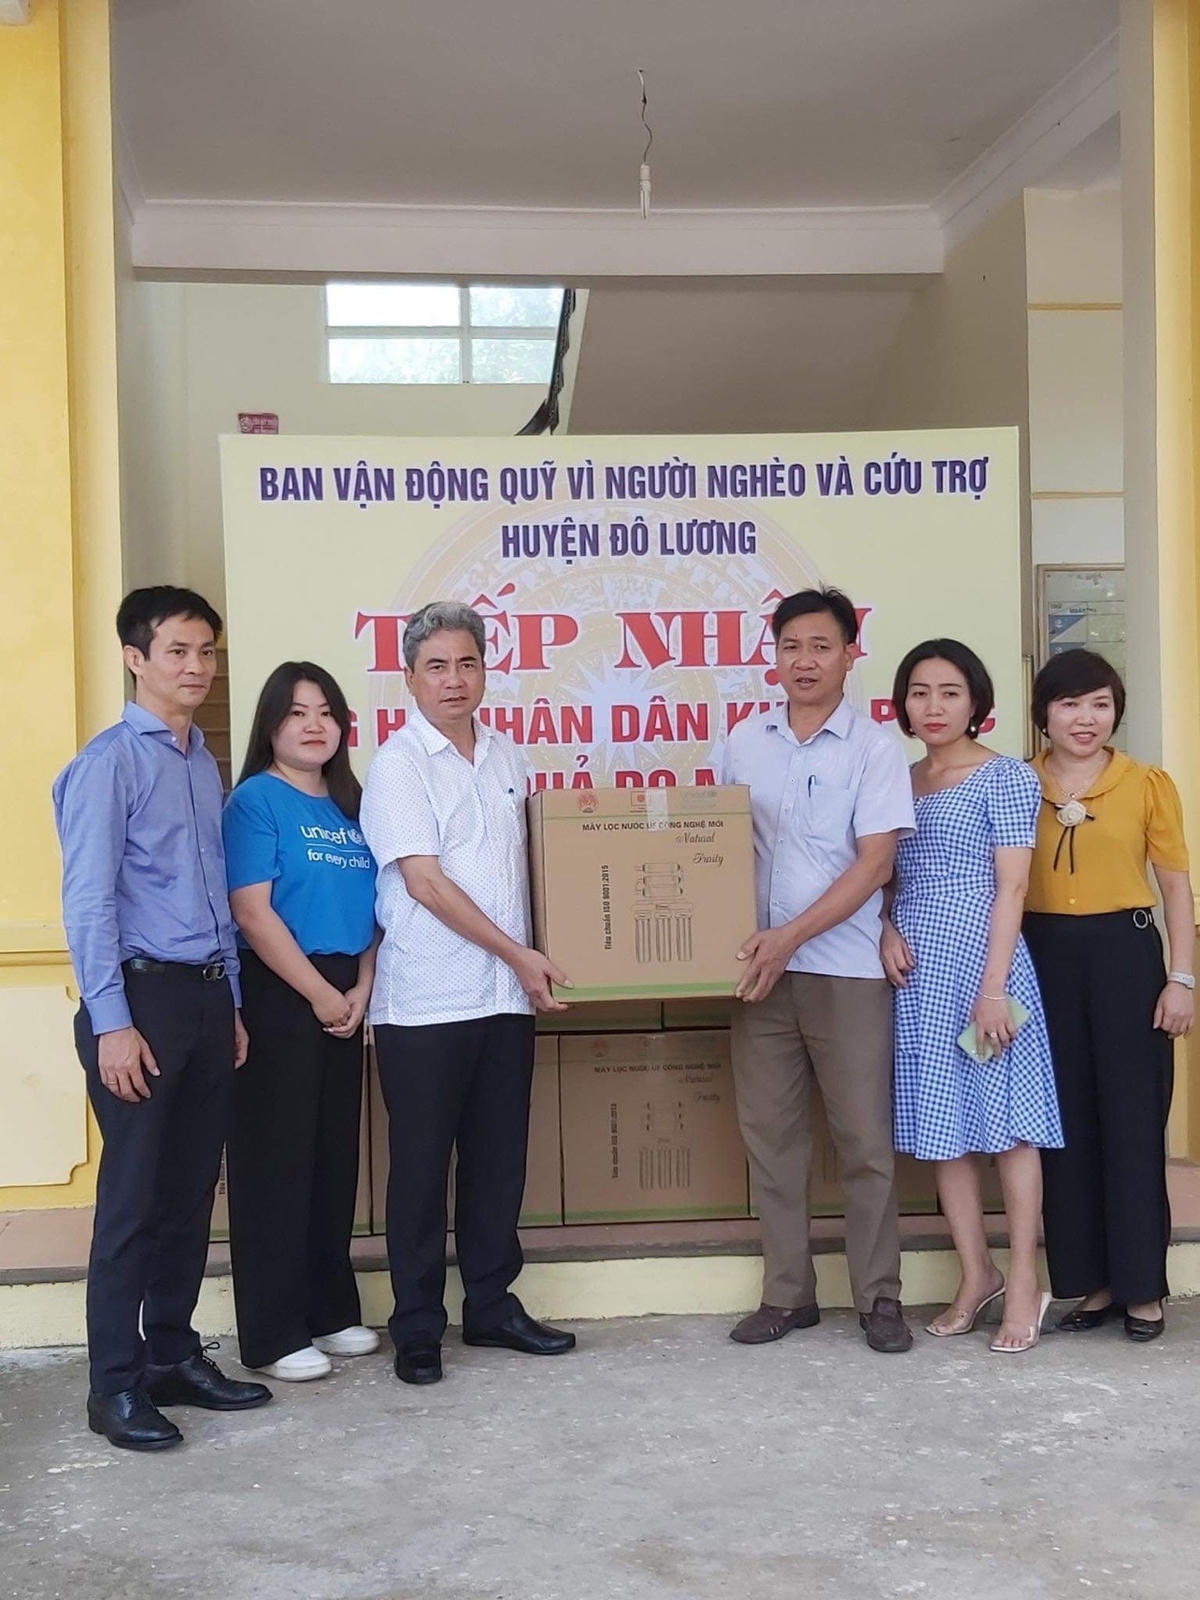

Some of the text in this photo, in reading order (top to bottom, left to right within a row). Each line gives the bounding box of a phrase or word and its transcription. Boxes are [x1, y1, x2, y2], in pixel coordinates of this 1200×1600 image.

[260, 452, 989, 509] BAN VẬN ĐỘNG QUỸ VÌ NGƯỜI NGHÈO VÀ CỨU TRỢ
[501, 516, 756, 564] HUYỆN ĐÔ LƯƠNG
[354, 582, 579, 674] TẾP
[611, 695, 709, 743] DÂN
[300, 825, 348, 845] unicef
[307, 848, 370, 869] for every child
